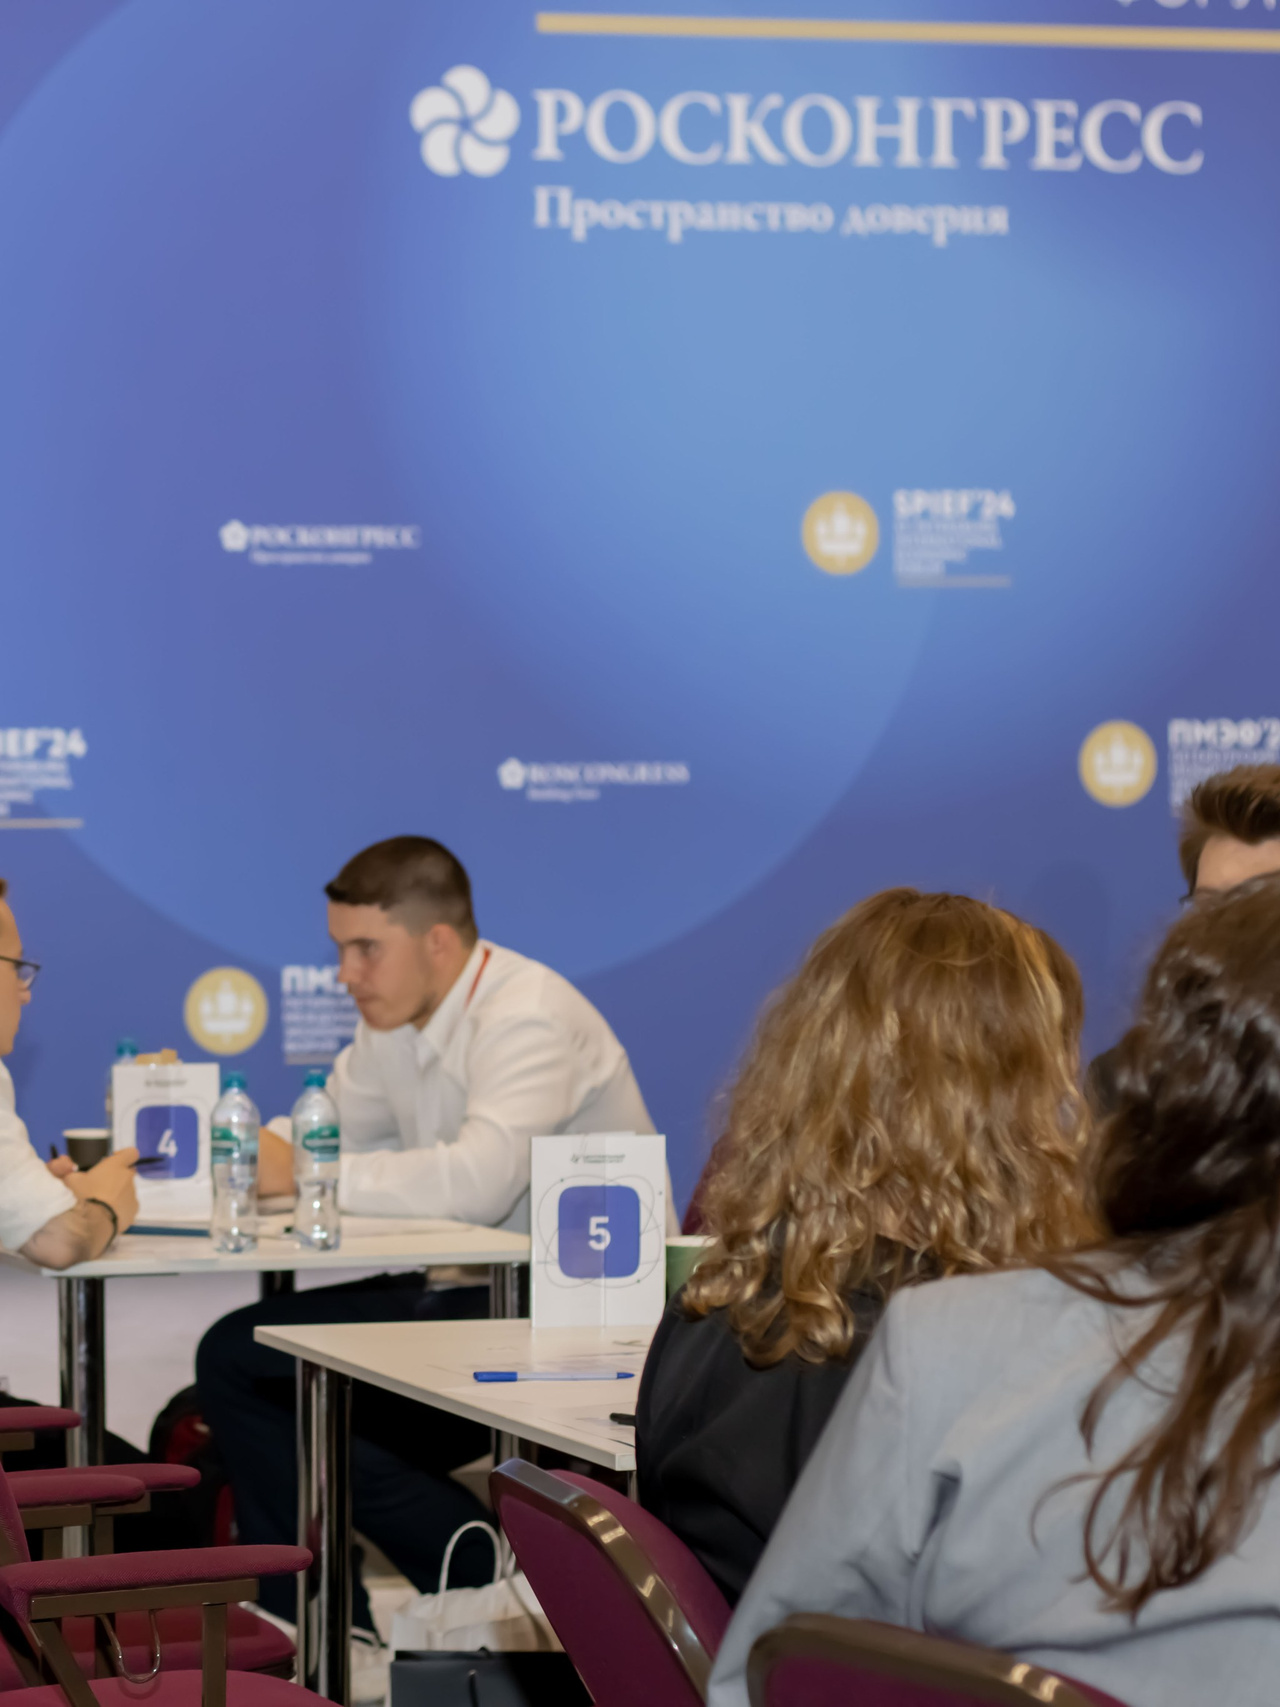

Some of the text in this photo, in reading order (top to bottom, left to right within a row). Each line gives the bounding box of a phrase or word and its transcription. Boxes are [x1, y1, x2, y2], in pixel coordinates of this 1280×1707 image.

[531, 88, 1205, 175] РОСКОНГРЕСС
[534, 185, 1009, 248] Пространство доверия
[157, 1129, 178, 1158] 4
[588, 1216, 611, 1250] 5
